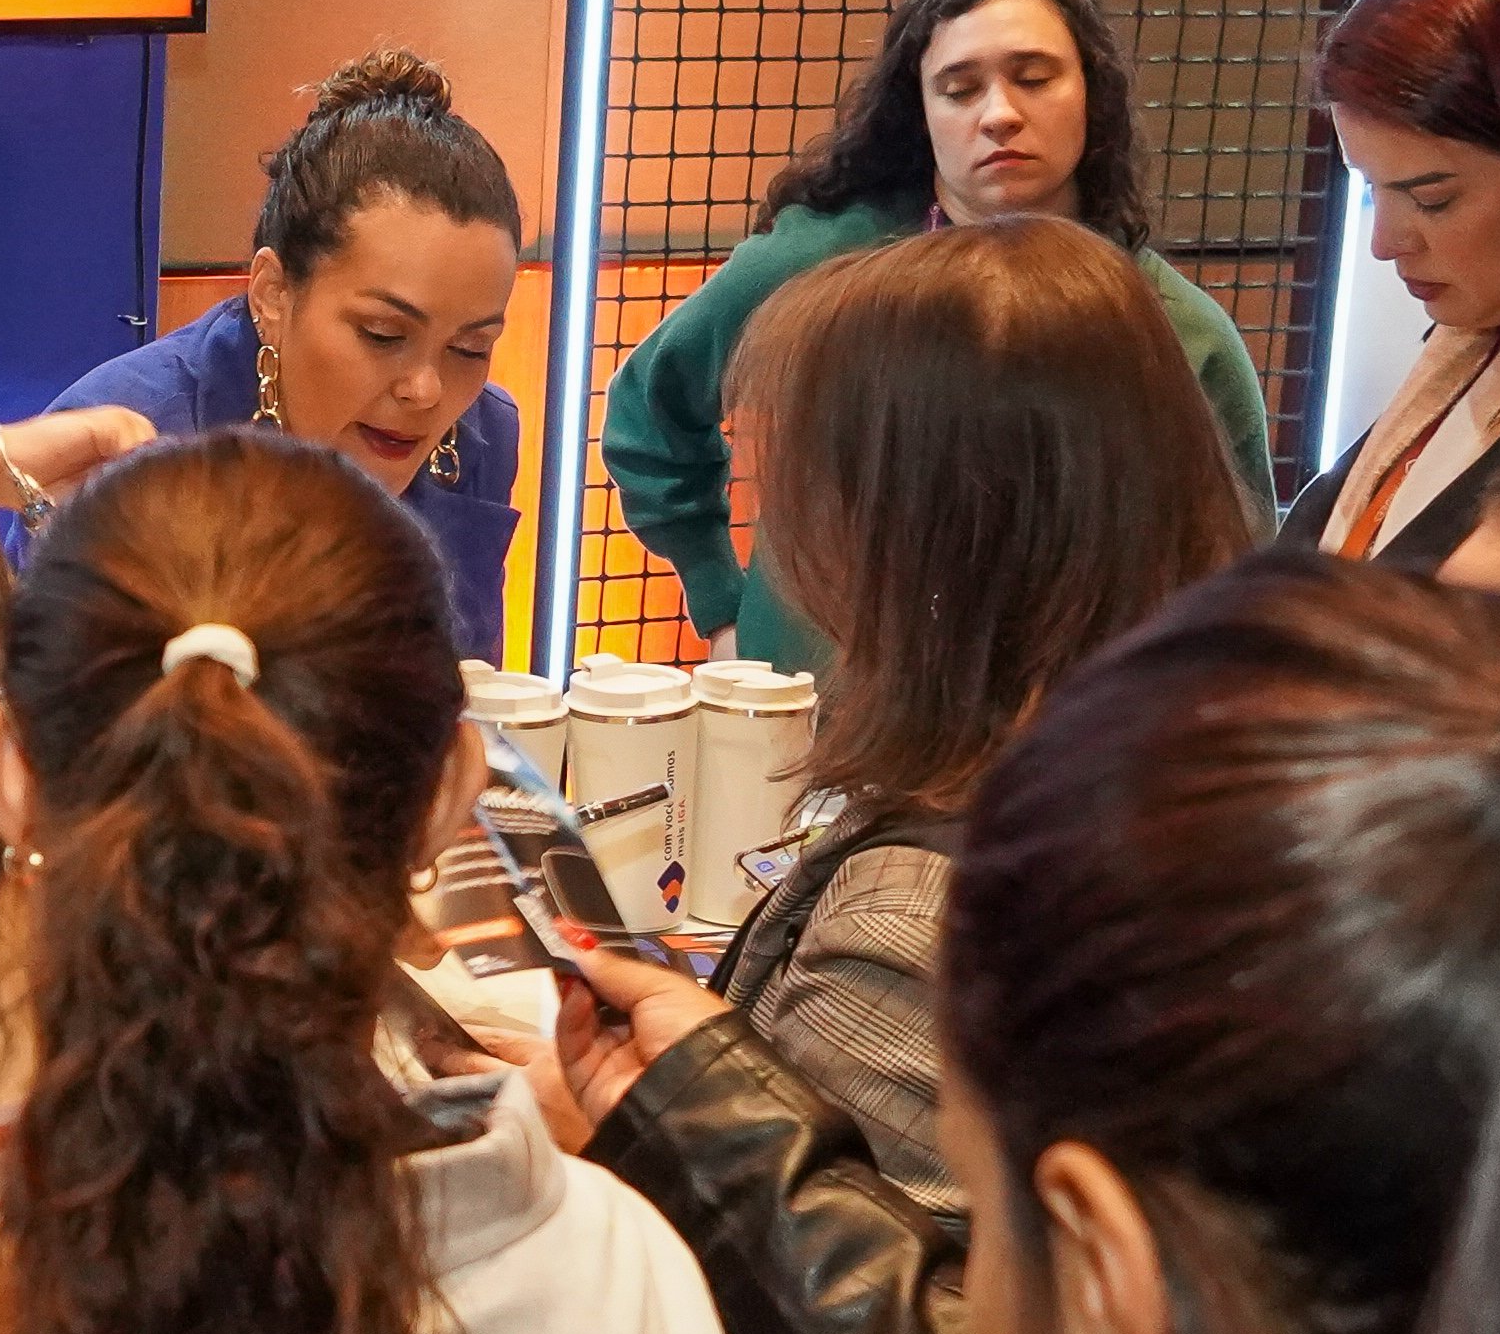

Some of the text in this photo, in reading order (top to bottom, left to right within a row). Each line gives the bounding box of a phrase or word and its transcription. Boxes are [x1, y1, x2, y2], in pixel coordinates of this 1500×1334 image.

[666, 750, 676, 791] omos
[664, 834, 673, 862] com
[677, 826, 686, 858] mais
